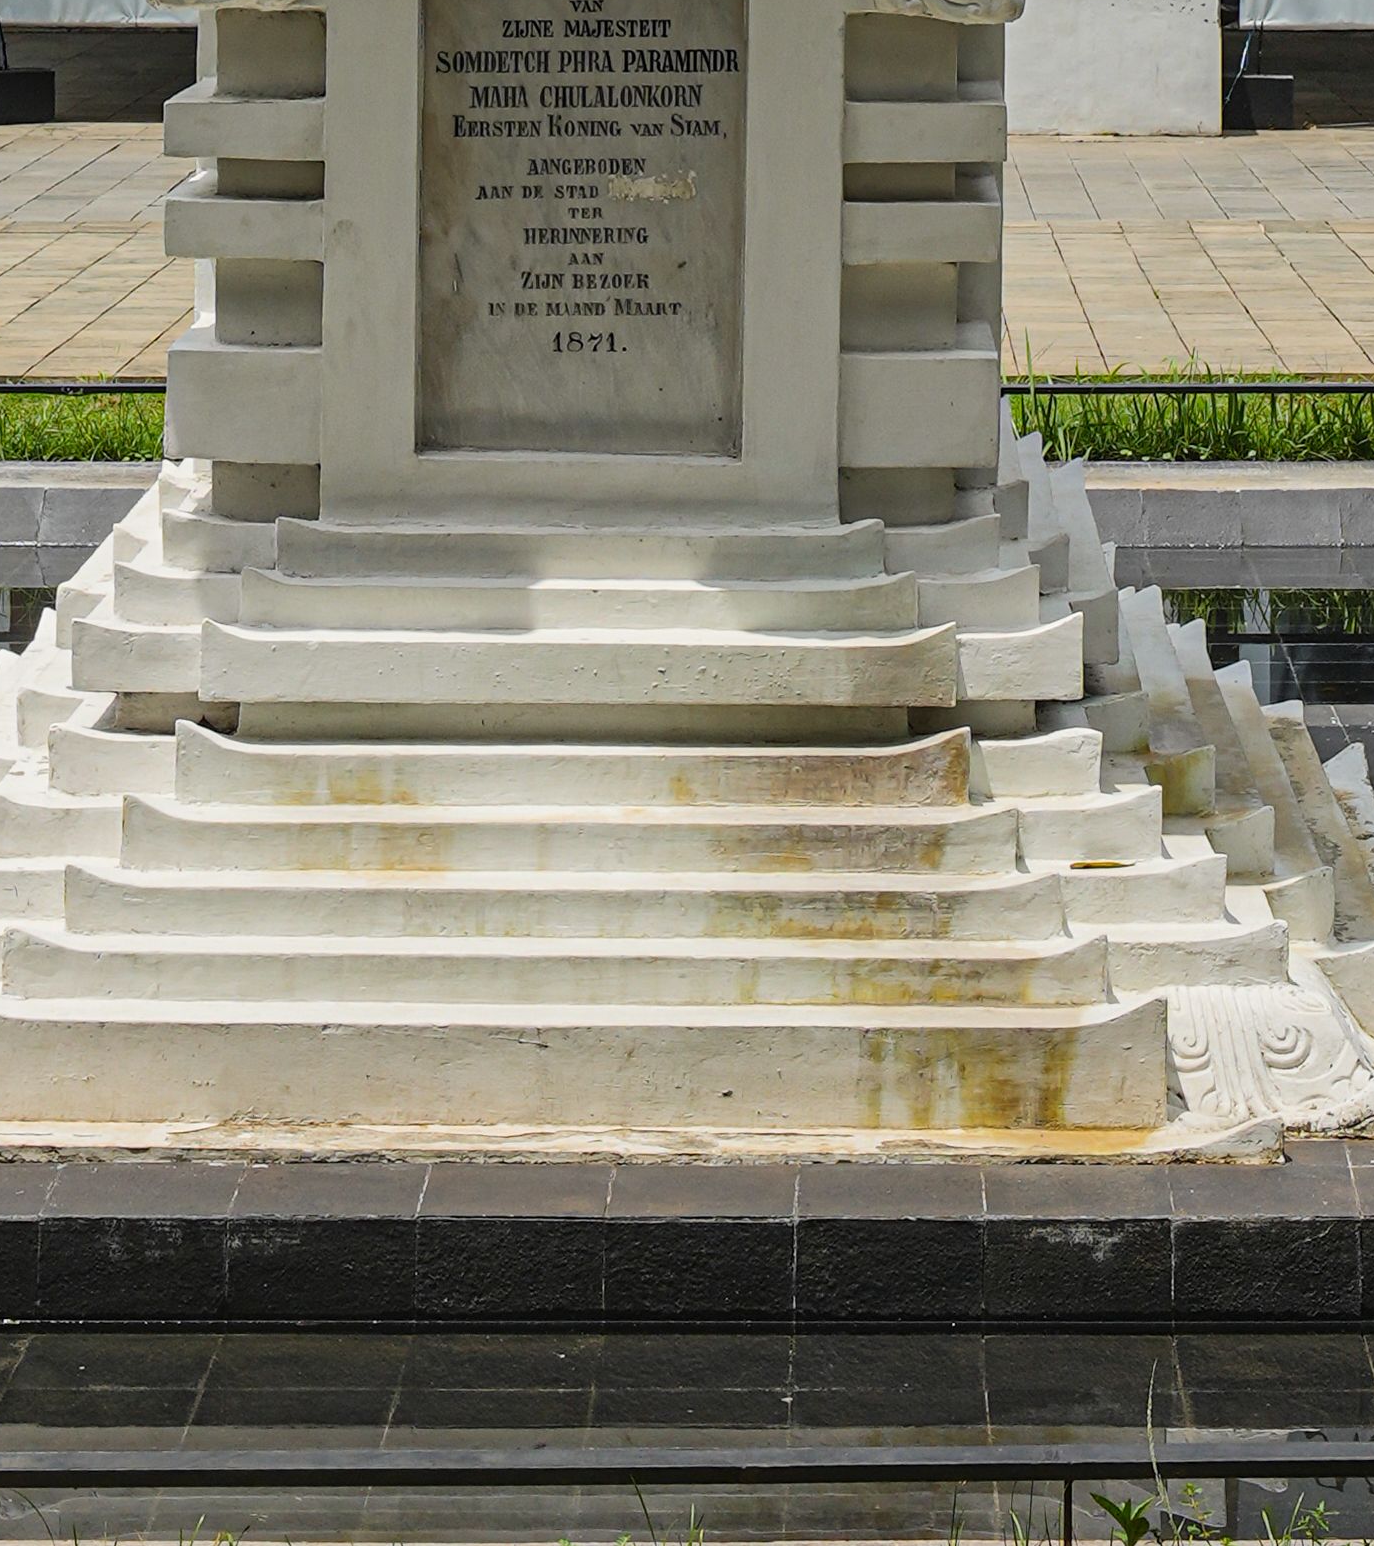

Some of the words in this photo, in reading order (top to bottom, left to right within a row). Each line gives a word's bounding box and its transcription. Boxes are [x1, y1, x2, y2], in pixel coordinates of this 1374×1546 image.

[570, 0, 604, 12] VAN
[502, 20, 554, 38] ZIJNE
[564, 19, 672, 38] MAJESTEIT
[436, 50, 550, 73] SOMDETCH
[557, 50, 615, 73] PHRA
[622, 49, 740, 73] PARAMINDR
[469, 85, 529, 109] MAHA
[540, 84, 703, 108] CHULALONKORN
[527, 158, 646, 176] AANGEBODEN
[475, 185, 514, 200] AAN
[522, 185, 543, 199] DE
[554, 185, 599, 199] STAD
[568, 207, 604, 219] TER
[523, 227, 649, 244] HERINNERING
[568, 253, 604, 266] AAN
[521, 272, 565, 290] ZIJN
[572, 274, 650, 290] BEZOEK
[488, 302, 505, 315] IN
[614, 298, 682, 316] MAART
[552, 331, 627, 353] 1871.
